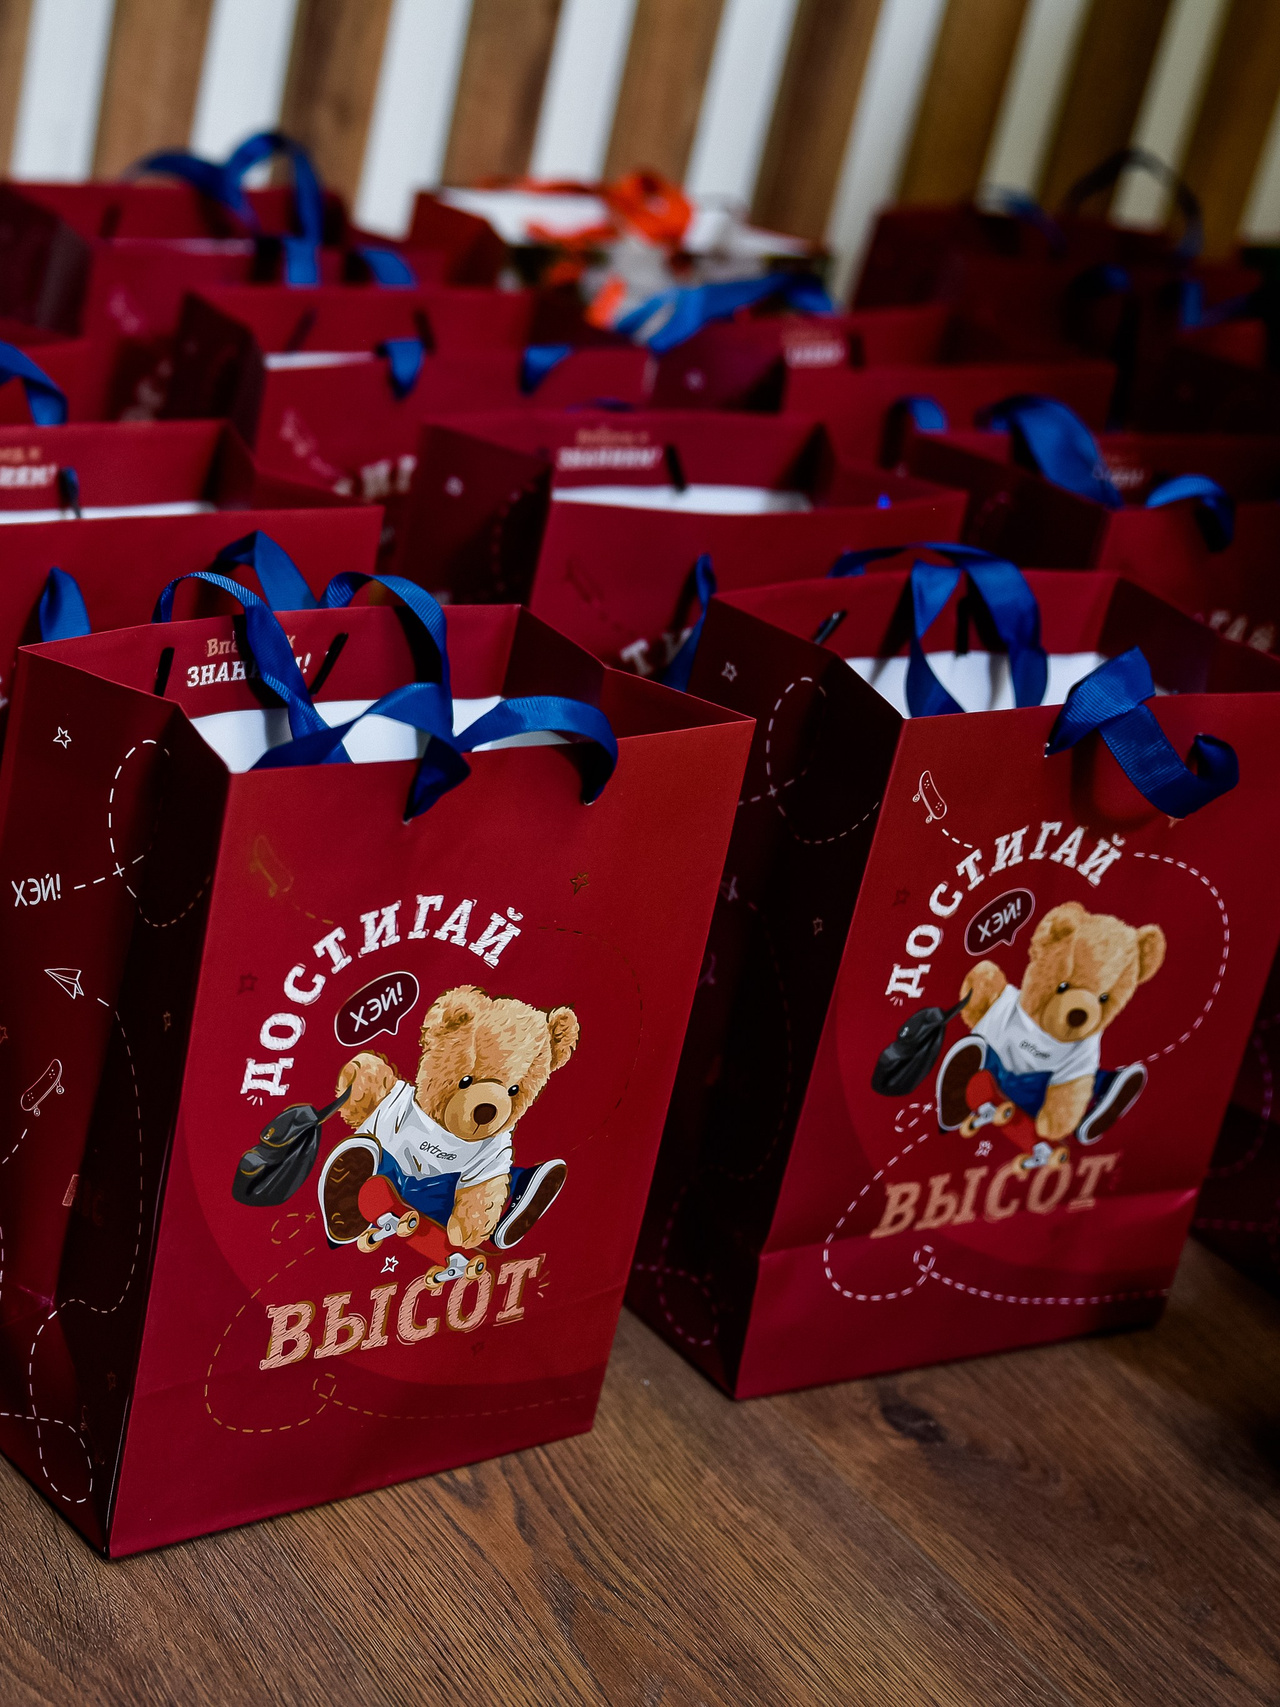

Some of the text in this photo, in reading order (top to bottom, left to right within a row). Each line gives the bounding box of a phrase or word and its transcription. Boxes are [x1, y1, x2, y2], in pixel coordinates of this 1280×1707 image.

[186, 652, 312, 688] ЗНАН!
[11, 872, 62, 908] ХЭЙ!
[885, 819, 1127, 1000] ДОСТИГАЙ
[977, 897, 1022, 943] ХЭЙ!
[241, 893, 526, 1097] ДОСТИГАЙ
[349, 981, 404, 1033] ХЭЙ!
[870, 1152, 1119, 1240] ВЫСОТ
[260, 1252, 545, 1371] ВЫСОТ
